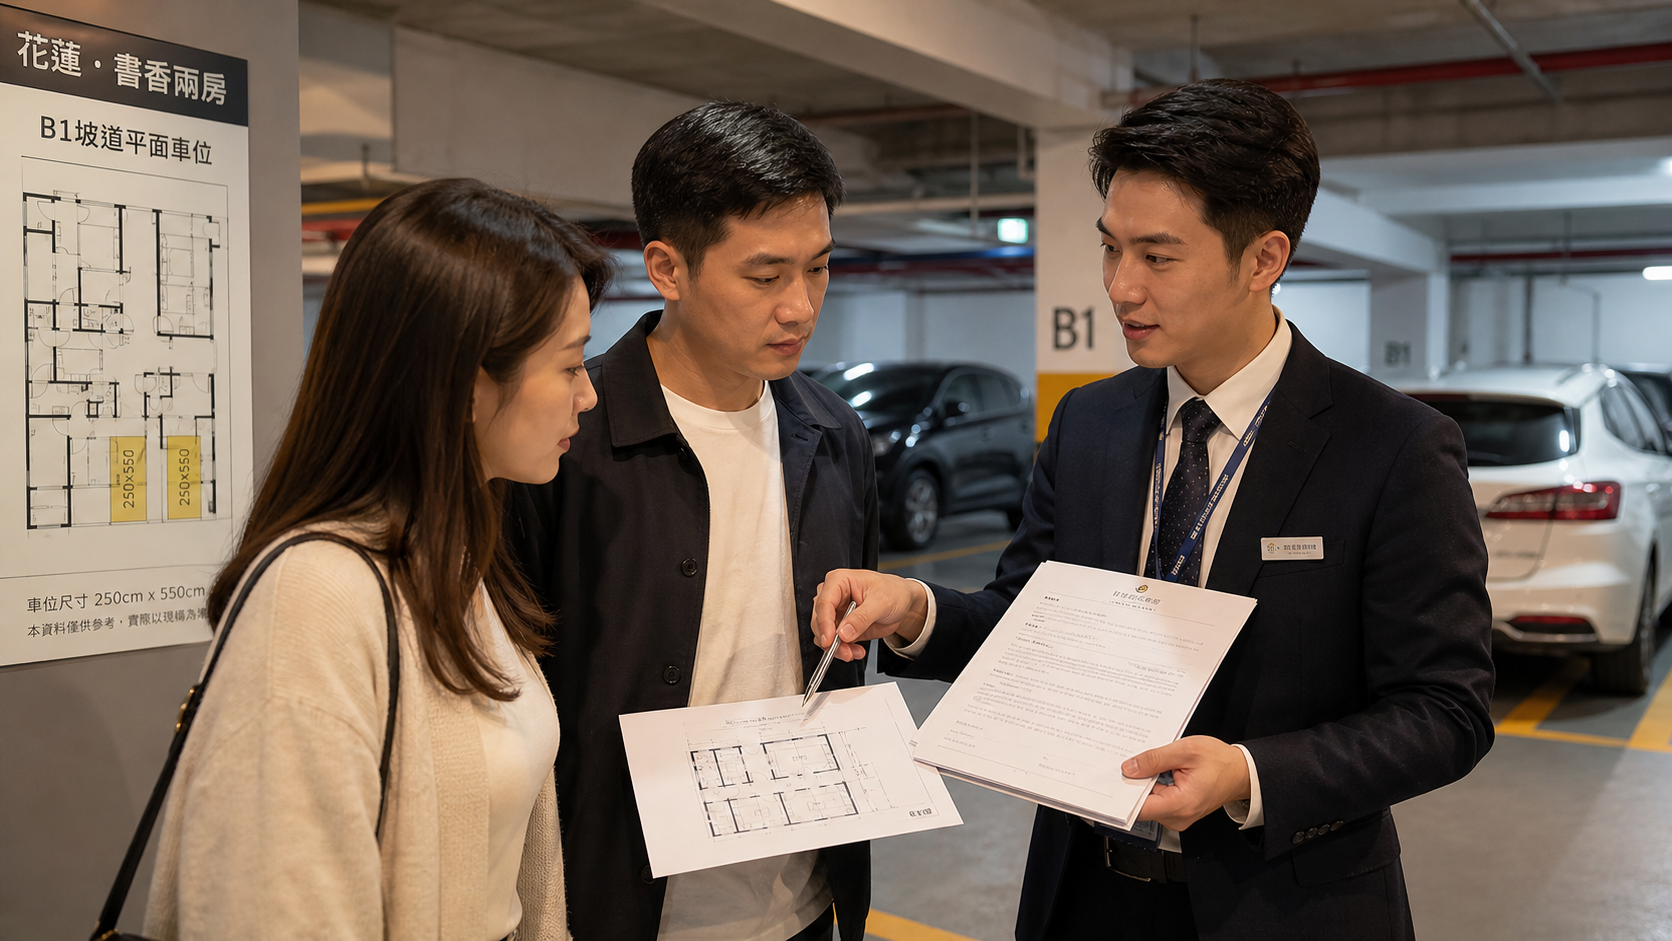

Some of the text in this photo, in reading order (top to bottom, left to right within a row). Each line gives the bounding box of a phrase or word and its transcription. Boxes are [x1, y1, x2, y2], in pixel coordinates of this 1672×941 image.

[40, 115, 213, 165] B1坡道平面車位
[1053, 307, 1094, 350] B1
[1385, 342, 1411, 367] B1
[27, 593, 88, 613] 車位尺寸
[95, 591, 143, 607] 250cm
[160, 585, 206, 600] 550cm
